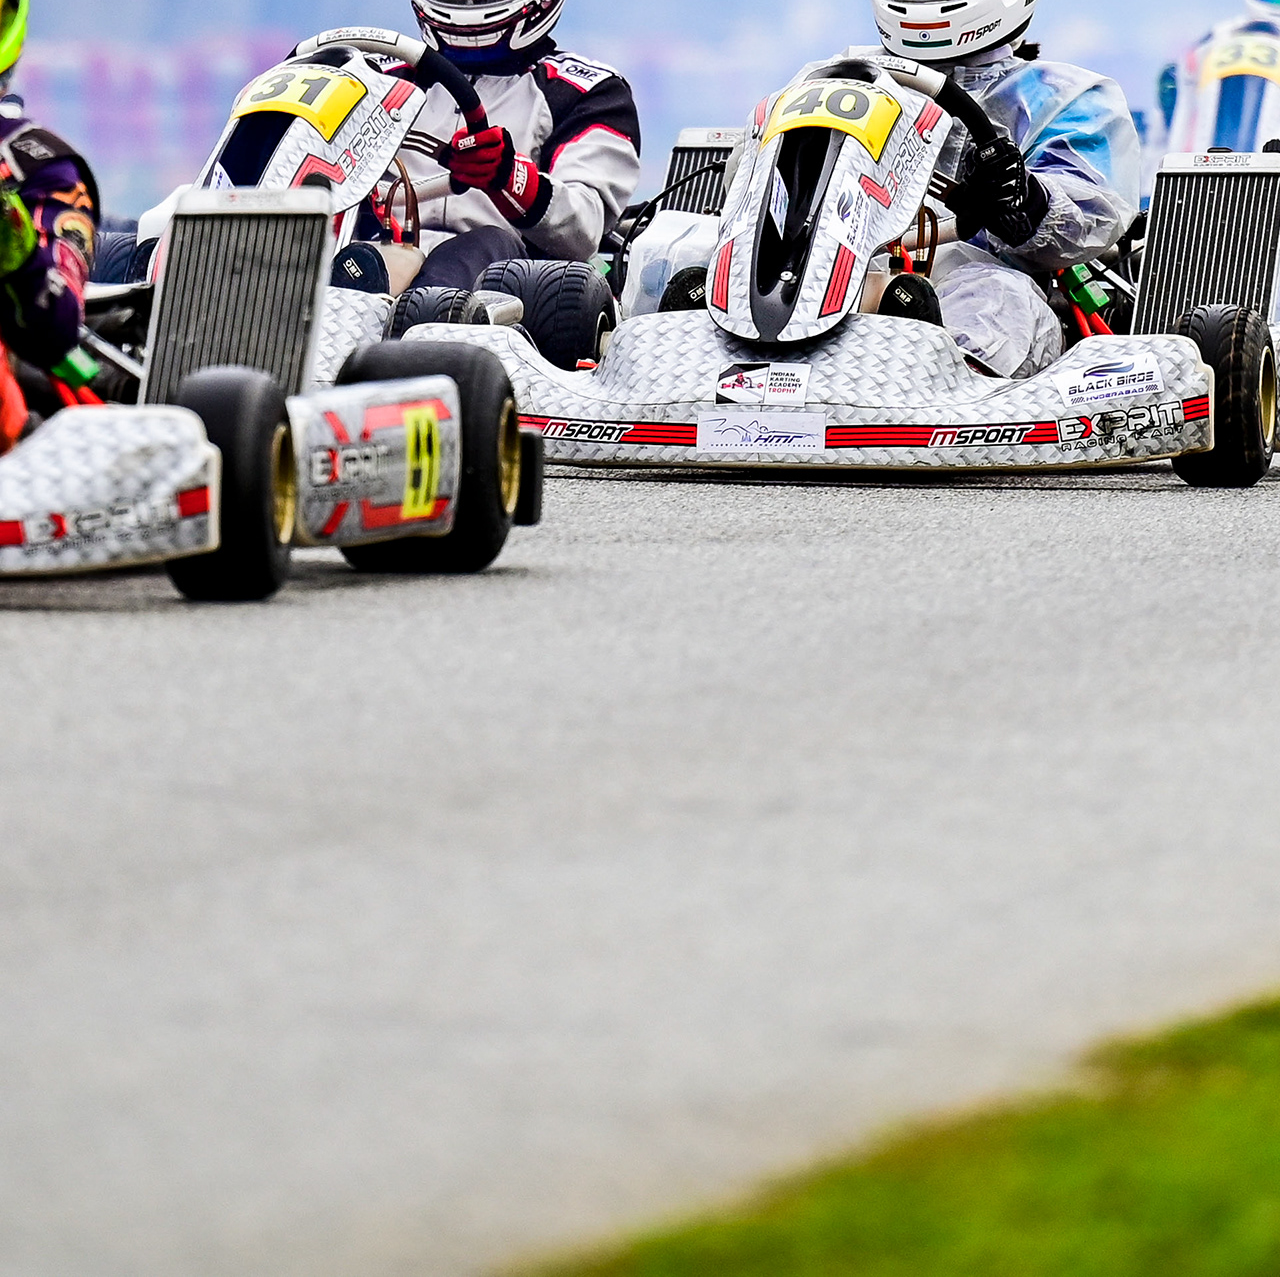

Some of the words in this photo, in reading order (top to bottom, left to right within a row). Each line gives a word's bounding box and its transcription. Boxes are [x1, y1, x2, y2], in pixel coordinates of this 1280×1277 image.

[1217, 44, 1279, 68] 33
[565, 64, 598, 80] OMP
[249, 72, 331, 106] 31
[782, 87, 870, 120] 40
[337, 104, 388, 178] EXPRIT
[458, 135, 476, 148] OMP
[885, 124, 922, 196] EXPRIT
[979, 147, 996, 160] OMP
[514, 161, 528, 196] OMP
[345, 259, 361, 278] OMP
[894, 287, 911, 303] OMP
[1068, 378, 1113, 396] BLACK
[1116, 371, 1154, 386] BIRDS
[1086, 387, 1145, 402] HYDERABAD
[1056, 401, 1184, 442] EXPRIT
[1061, 432, 1127, 453] RACING
